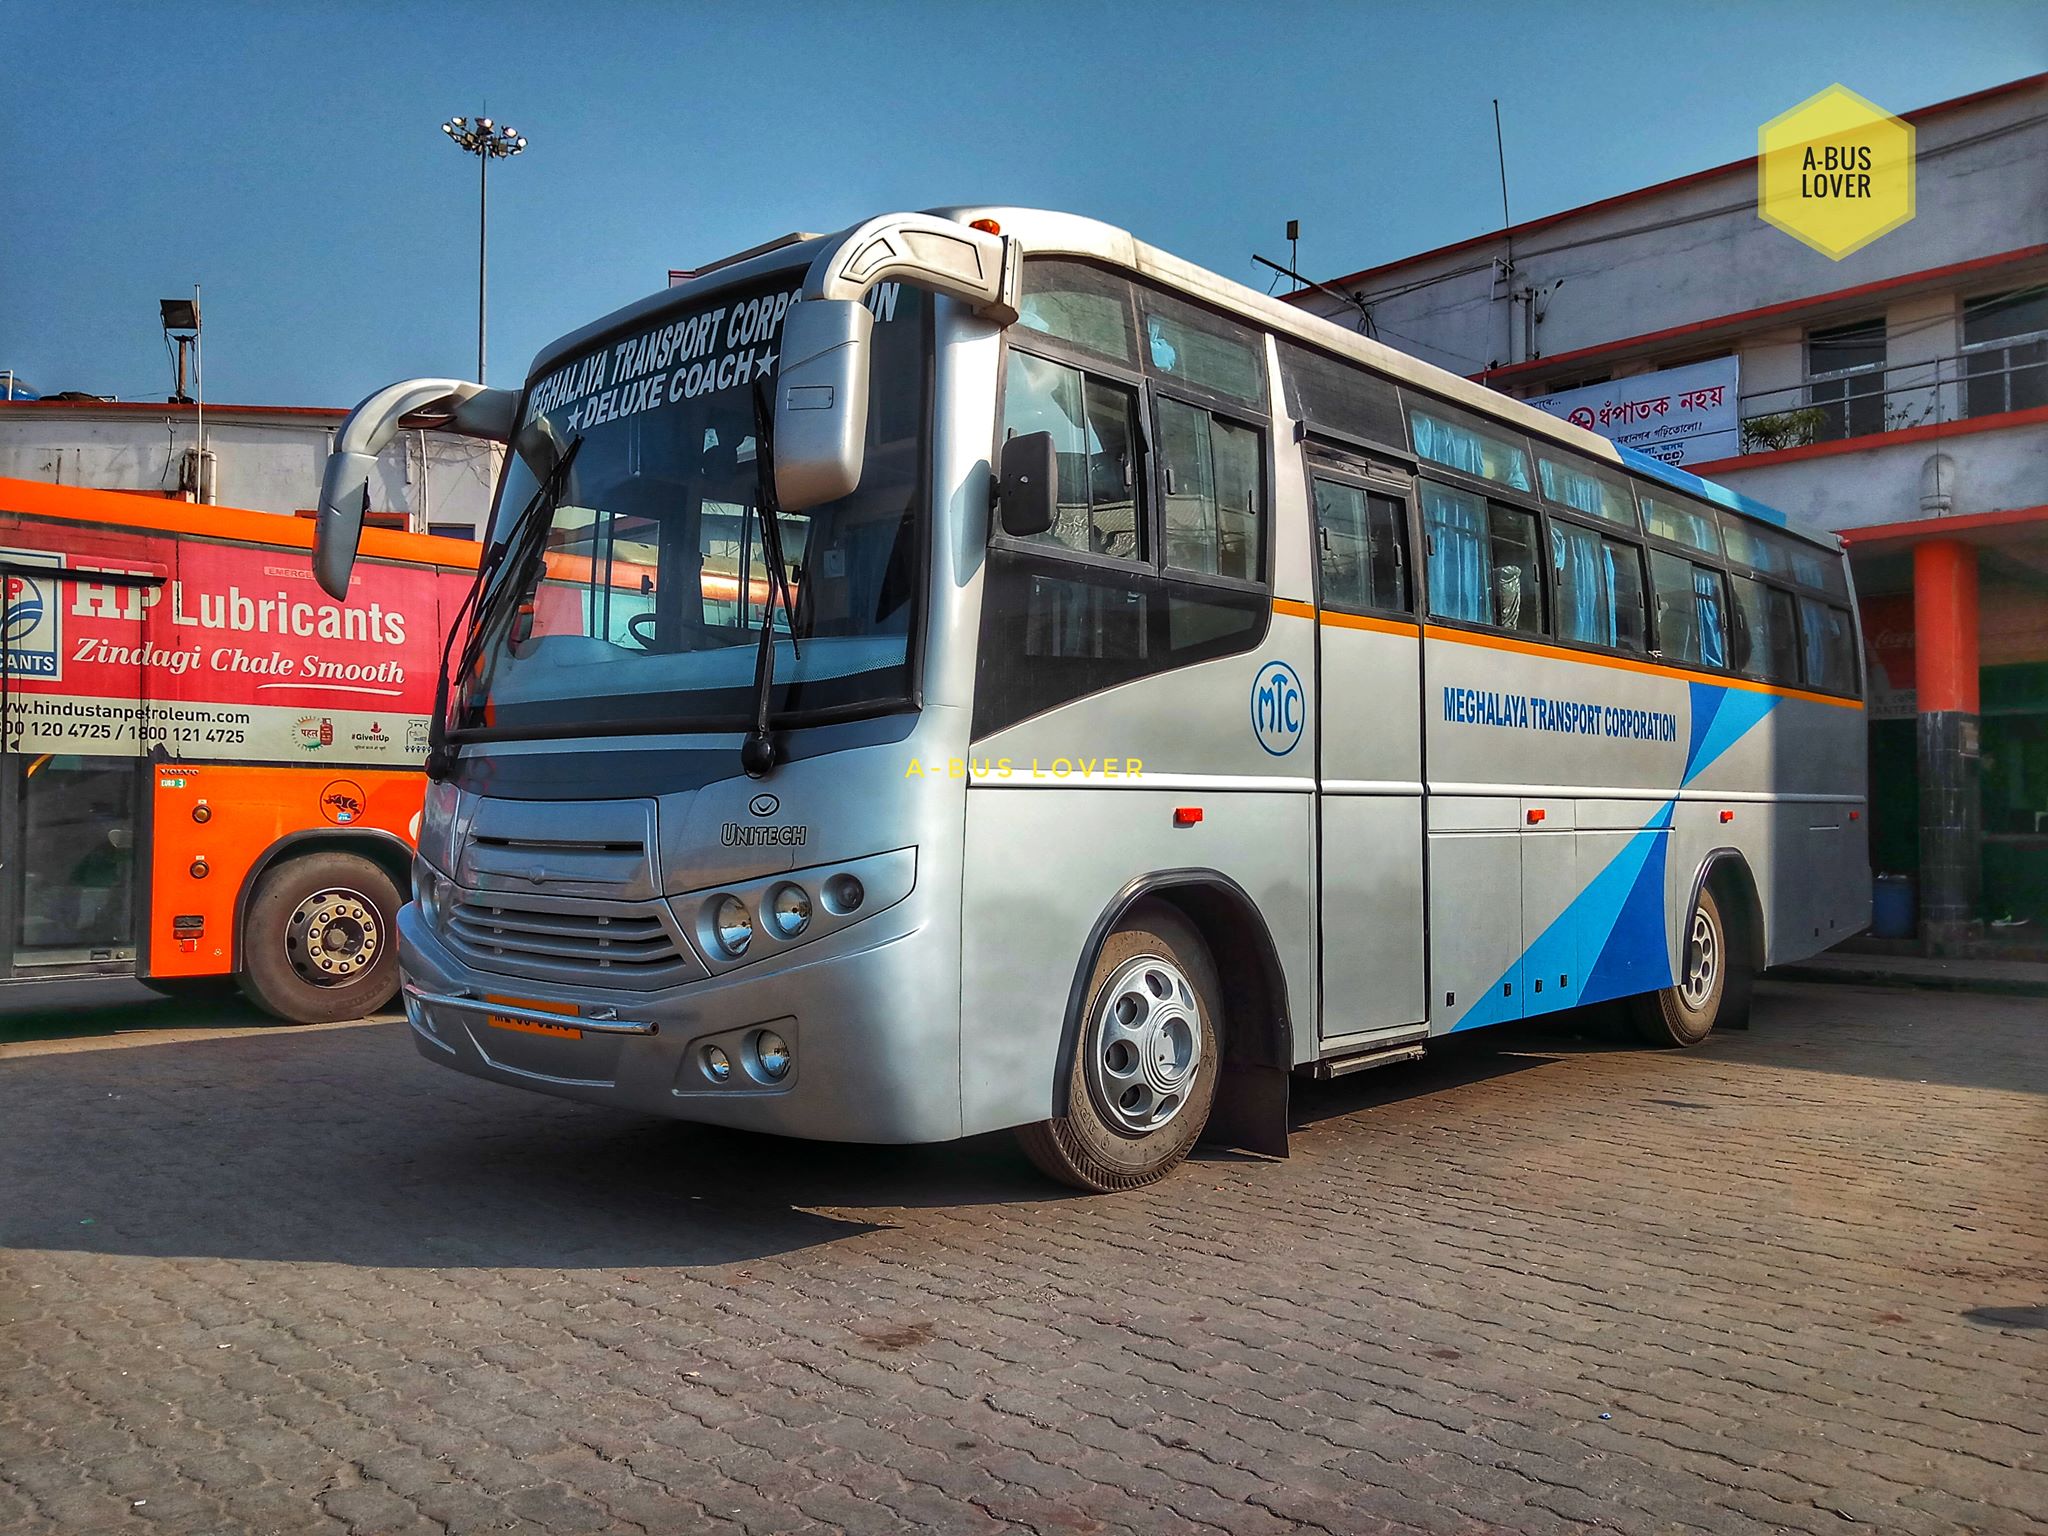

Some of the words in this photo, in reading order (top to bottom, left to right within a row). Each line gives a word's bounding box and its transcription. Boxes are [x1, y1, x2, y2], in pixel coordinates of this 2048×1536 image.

[522, 350, 609, 431] MEGHALAYA
[611, 308, 727, 386] TRANSPORT
[582, 373, 668, 431] DELUXE
[668, 348, 756, 404] COACH
[172, 580, 406, 645] Lubricants
[72, 638, 201, 675] Zindagi
[210, 648, 295, 674] Chale
[300, 655, 405, 684] Smooth
[31, 722, 63, 737] 120
[68, 723, 112, 740] 4725
[128, 726, 168, 741] 1800
[172, 728, 200, 742] 121
[205, 729, 245, 743] 4725
[1258, 673, 1299, 734] MTC
[1443, 686, 1529, 729] MEGHALAYA
[1530, 697, 1602, 736] TRANSPORT
[1604, 707, 1677, 743] CORPORATION
